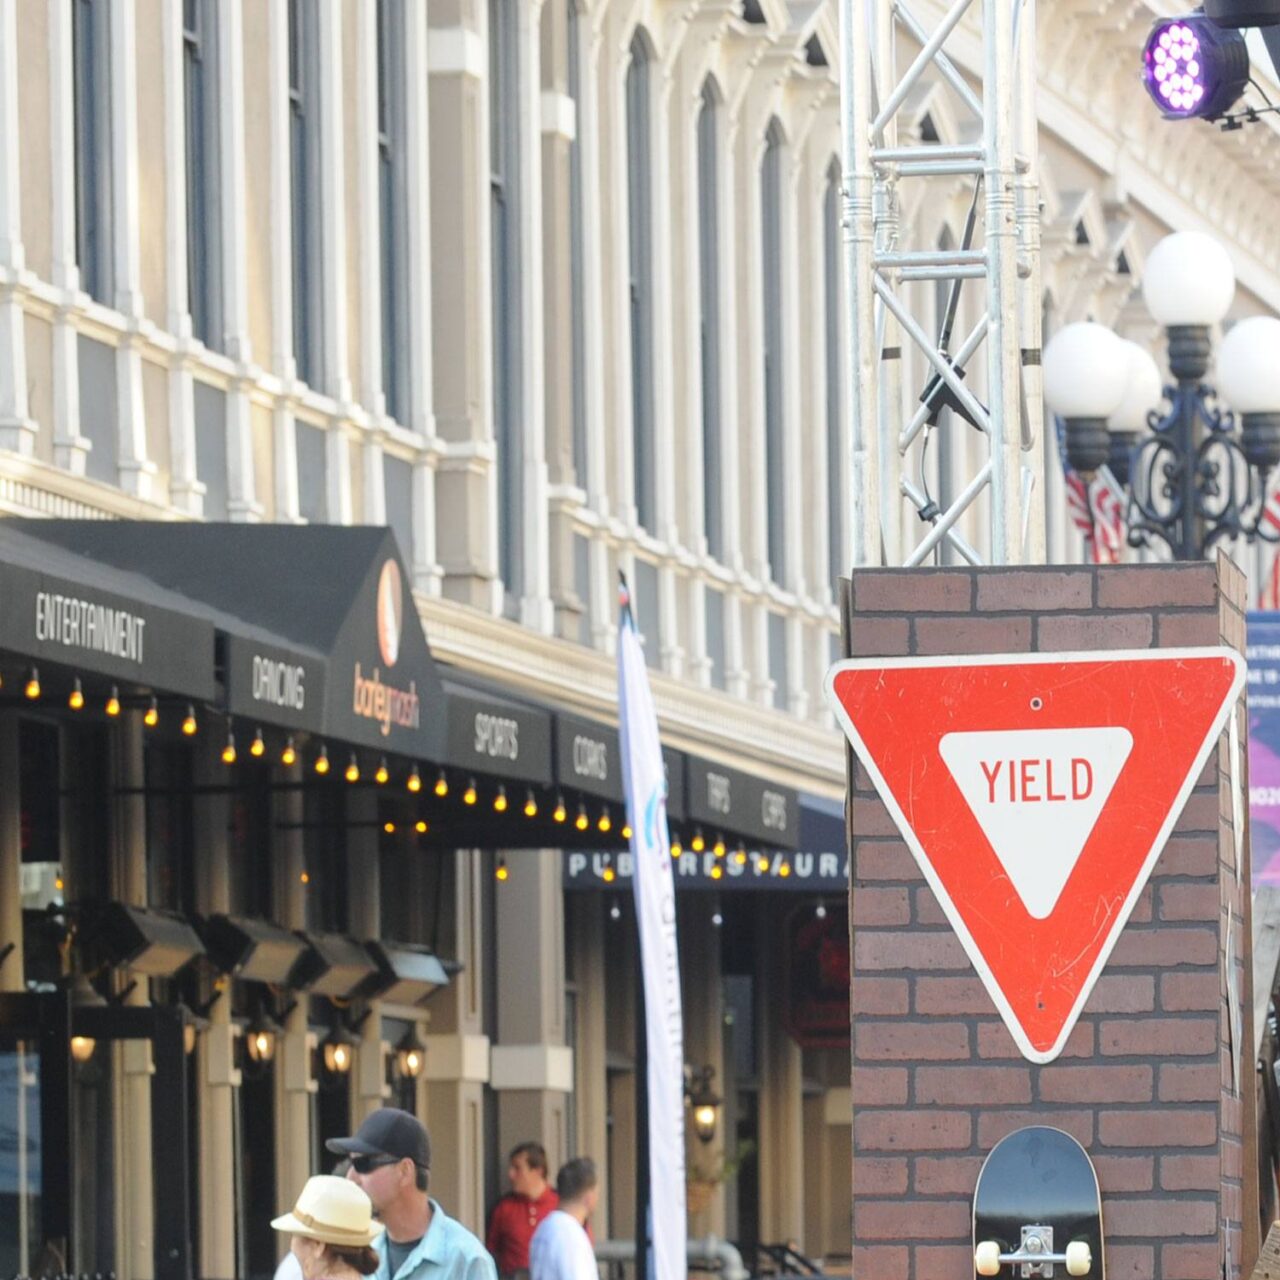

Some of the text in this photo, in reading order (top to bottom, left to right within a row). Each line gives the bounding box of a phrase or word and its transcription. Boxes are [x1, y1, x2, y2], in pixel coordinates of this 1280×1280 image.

[36, 591, 146, 664] ENTERTAINMENT
[252, 654, 303, 710] DANCING
[474, 711, 519, 761] SPORTS
[573, 734, 608, 781] CORKS
[980, 757, 1093, 803] YIELD
